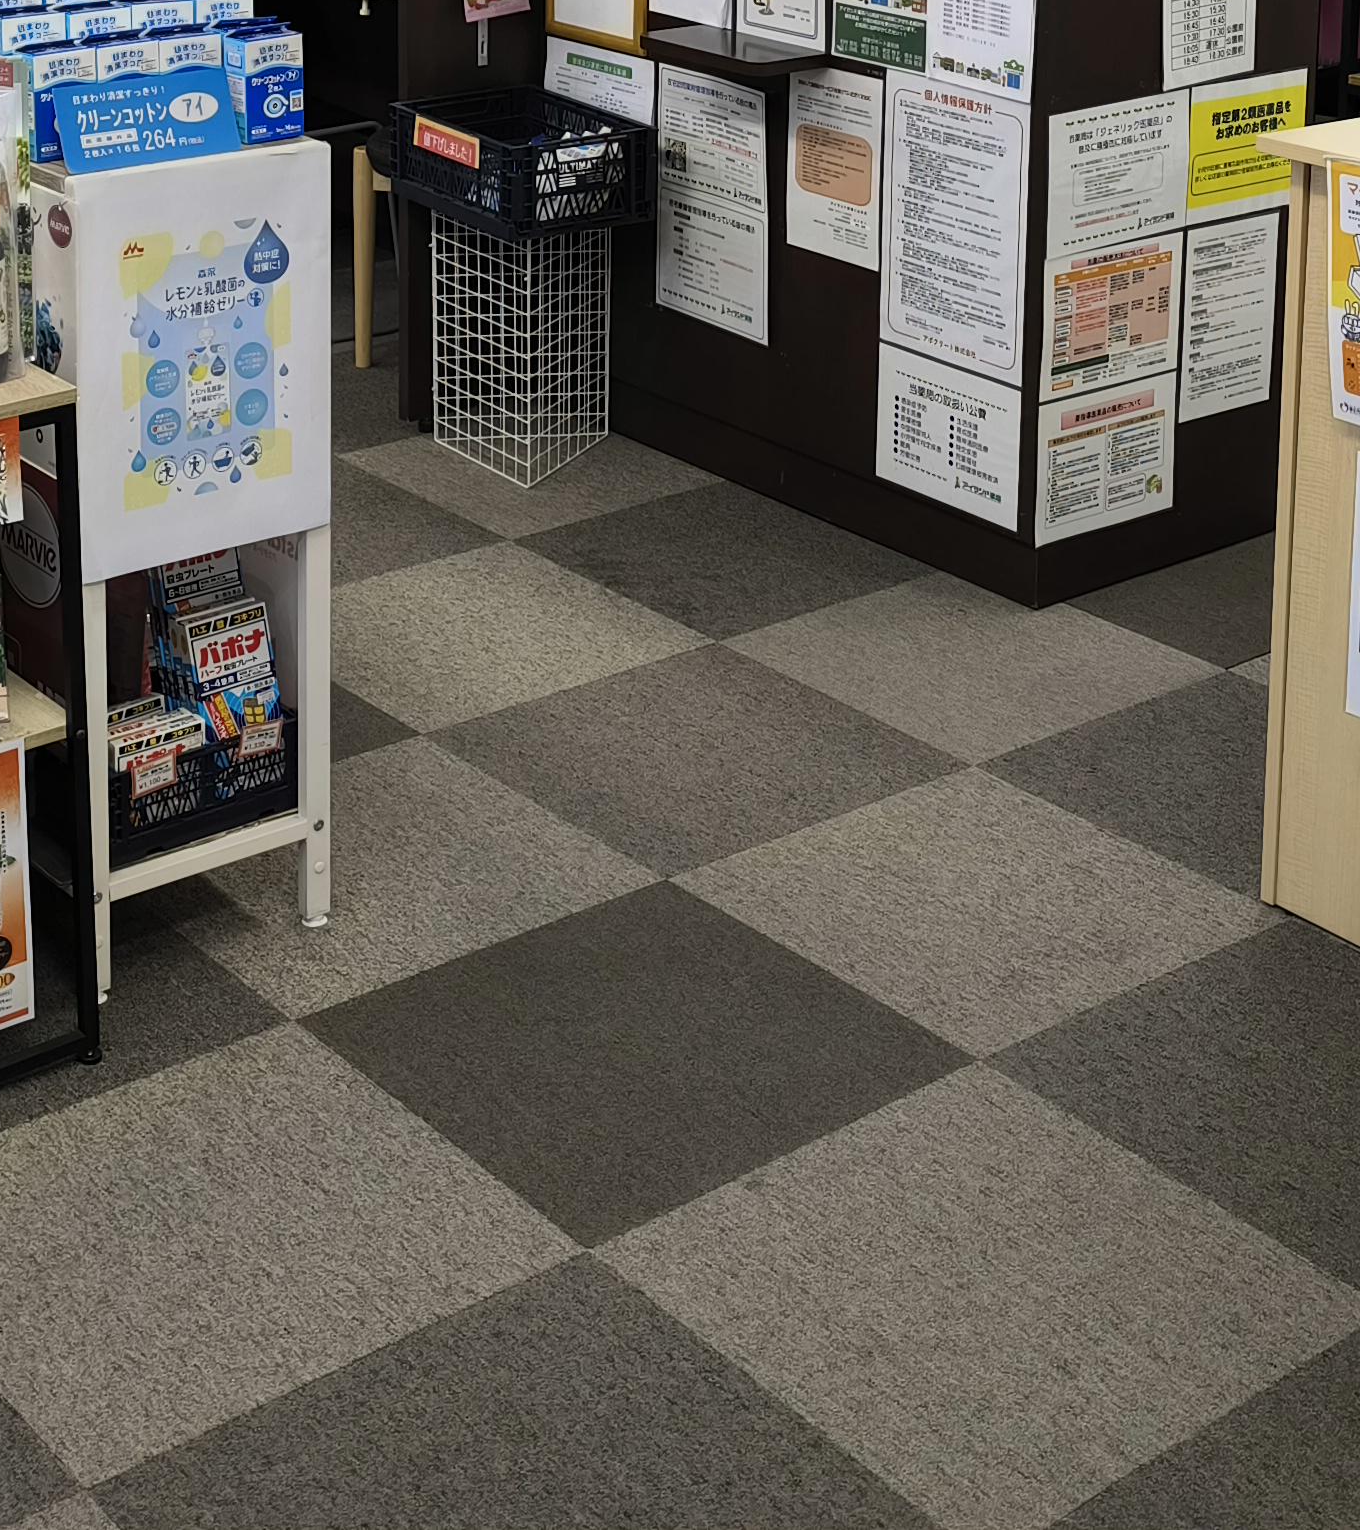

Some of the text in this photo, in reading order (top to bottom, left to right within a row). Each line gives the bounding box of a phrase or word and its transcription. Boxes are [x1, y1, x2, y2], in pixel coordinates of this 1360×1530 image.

[111, 49, 145, 61] 目まわり
[173, 43, 207, 54] 目まわり
[48, 57, 81, 68] 目まわり
[181, 97, 206, 117] アイ
[1210, 99, 1293, 128] 指定第2類医薬品を
[76, 101, 168, 134] クリーンコットン
[1214, 116, 1287, 142] お求めのお客様へ
[557, 159, 604, 174] ULTIMATE
[253, 248, 281, 262] 熱中症
[164, 277, 246, 303] レモンと乳酸菌の
[165, 296, 246, 322] 水分補給ゼリー
[165, 564, 216, 585] 殺虫プレート
[232, 607, 263, 623] ゴキブリ
[191, 624, 208, 636] ハエ
[198, 628, 266, 668] バポナ
[223, 656, 259, 671] 殺虫プレート
